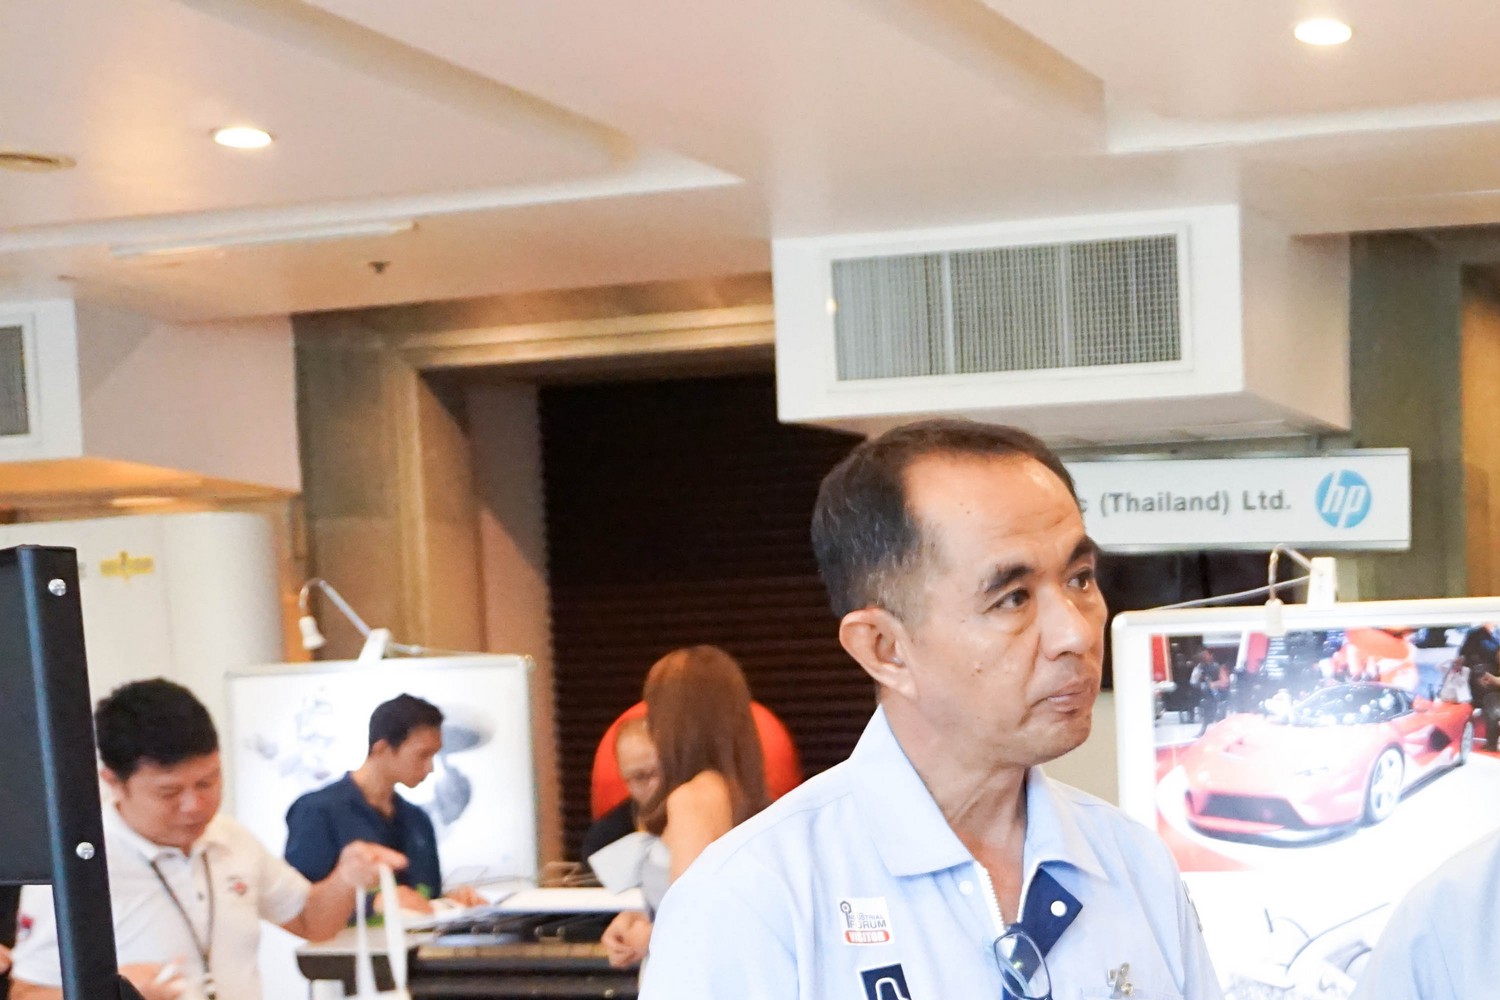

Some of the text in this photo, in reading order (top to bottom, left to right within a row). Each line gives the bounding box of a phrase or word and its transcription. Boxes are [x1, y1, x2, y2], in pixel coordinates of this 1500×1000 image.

[1100, 490, 1230, 516] (Thailand)
[1242, 489, 1292, 511] Ltd.
[1320, 470, 1368, 528] hp
